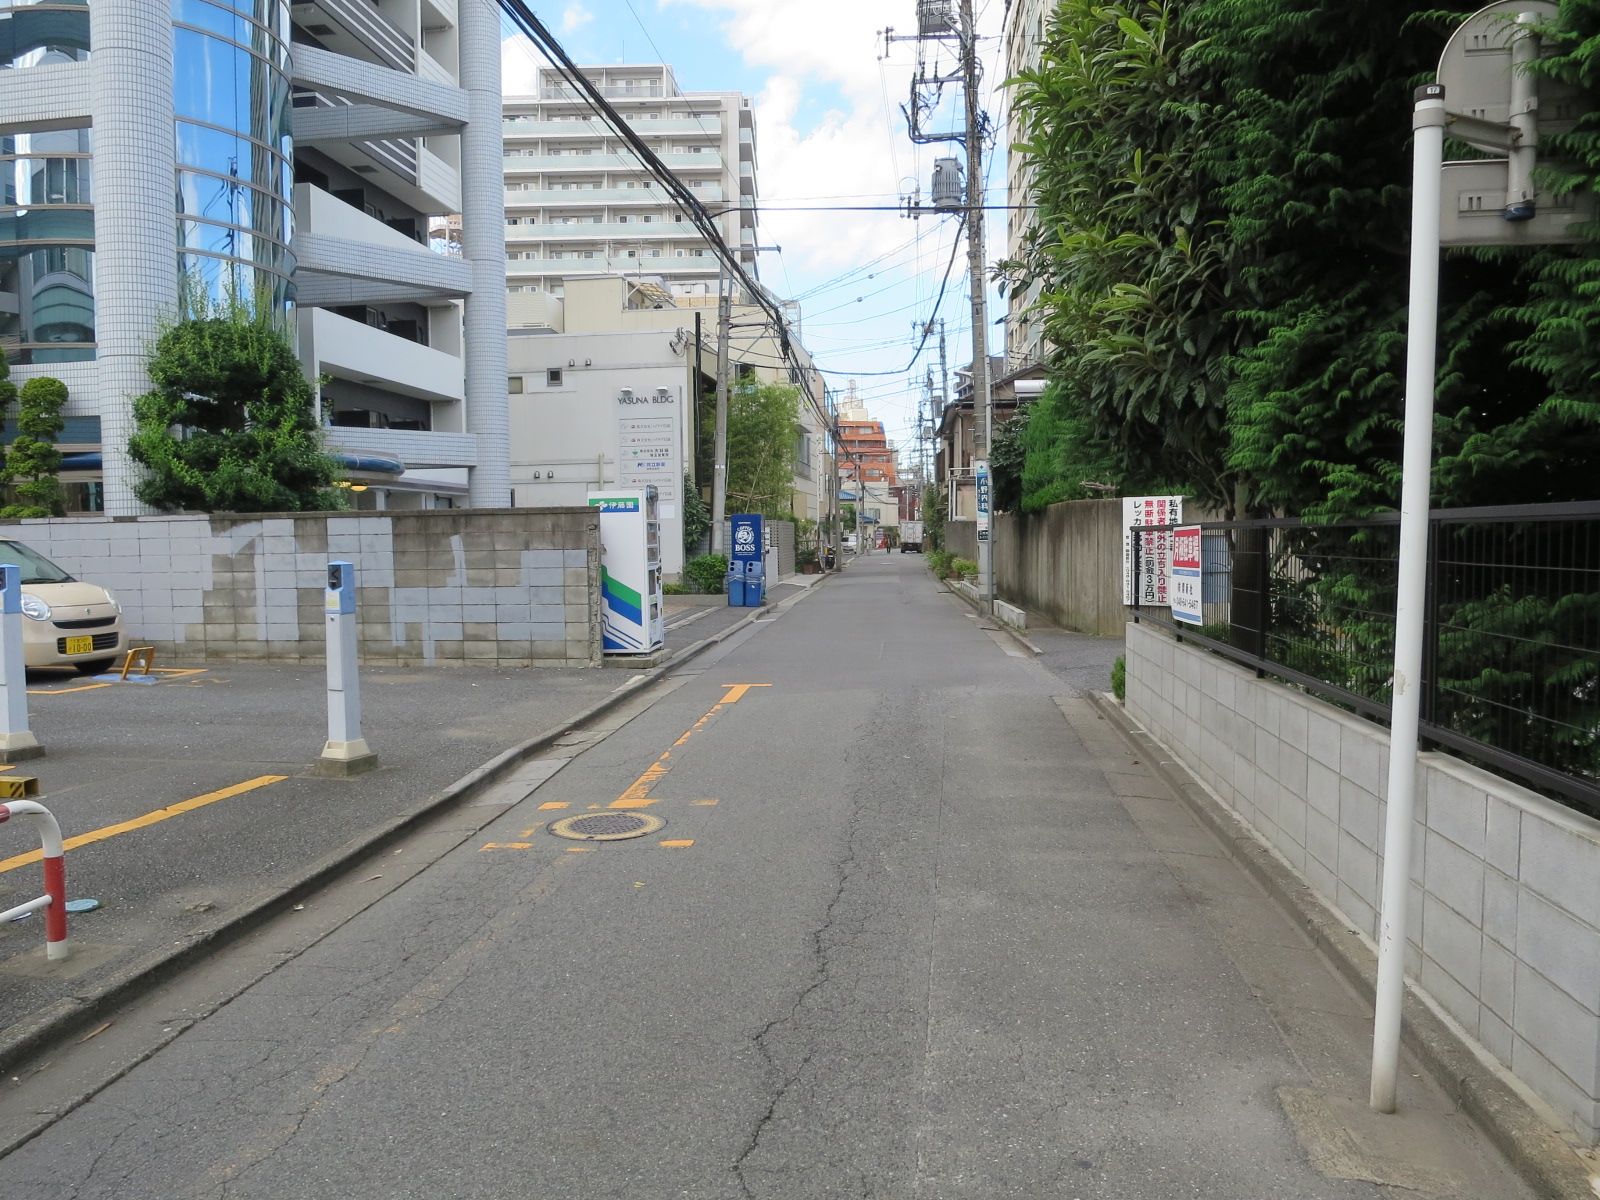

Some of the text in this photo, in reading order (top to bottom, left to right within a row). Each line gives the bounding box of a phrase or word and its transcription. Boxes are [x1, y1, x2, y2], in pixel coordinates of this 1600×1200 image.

[617, 396, 649, 405] YASUNA
[608, 501, 634, 510] 伊藤園
[734, 544, 756, 552] BOSS
